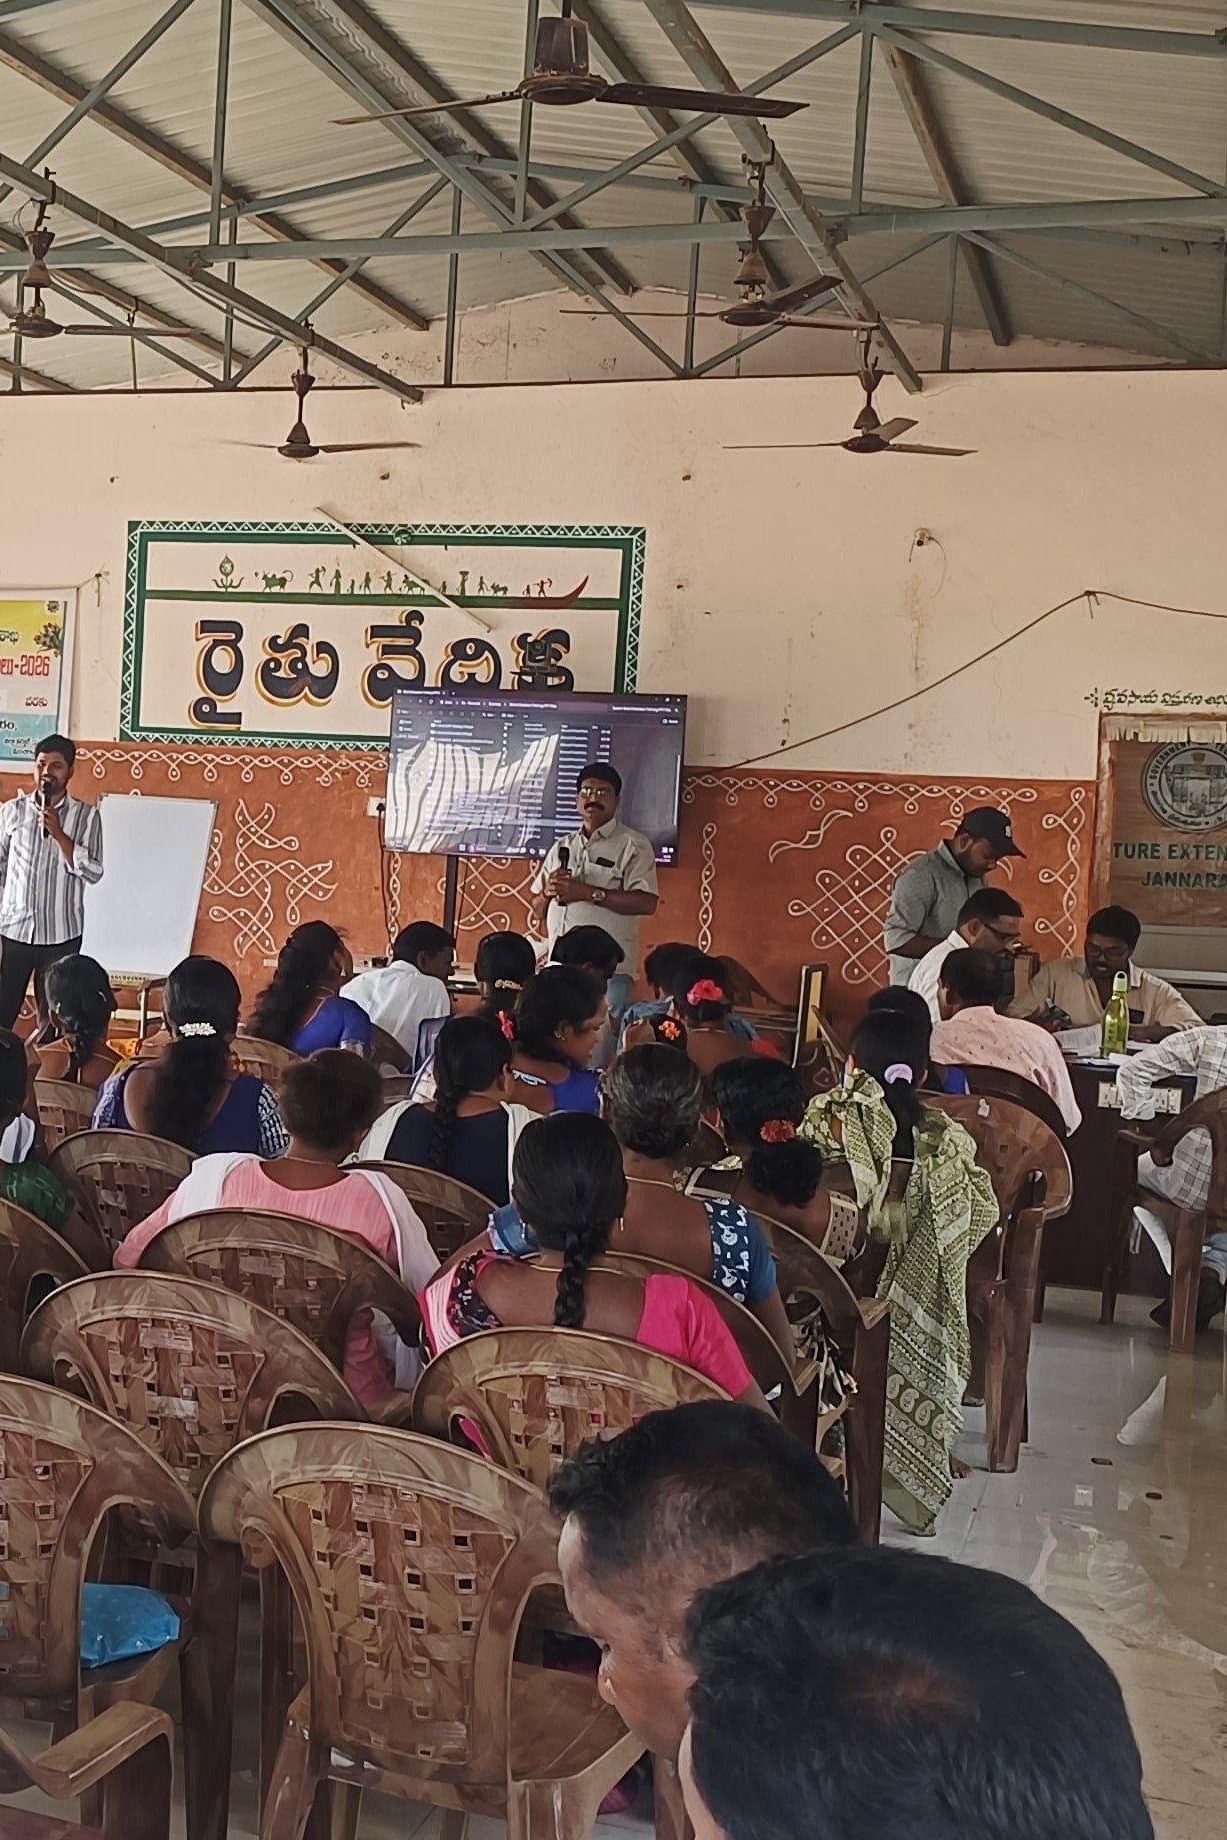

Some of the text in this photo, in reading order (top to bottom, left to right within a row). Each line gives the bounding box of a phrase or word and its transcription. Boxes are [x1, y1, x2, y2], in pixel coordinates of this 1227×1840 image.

[187, 619, 341, 732] రైతు
[1102, 688, 1158, 711] వ్యవసాయ
[1161, 689, 1203, 707] విస్తరణ
[1113, 842, 1227, 861] TURE EXTEN
